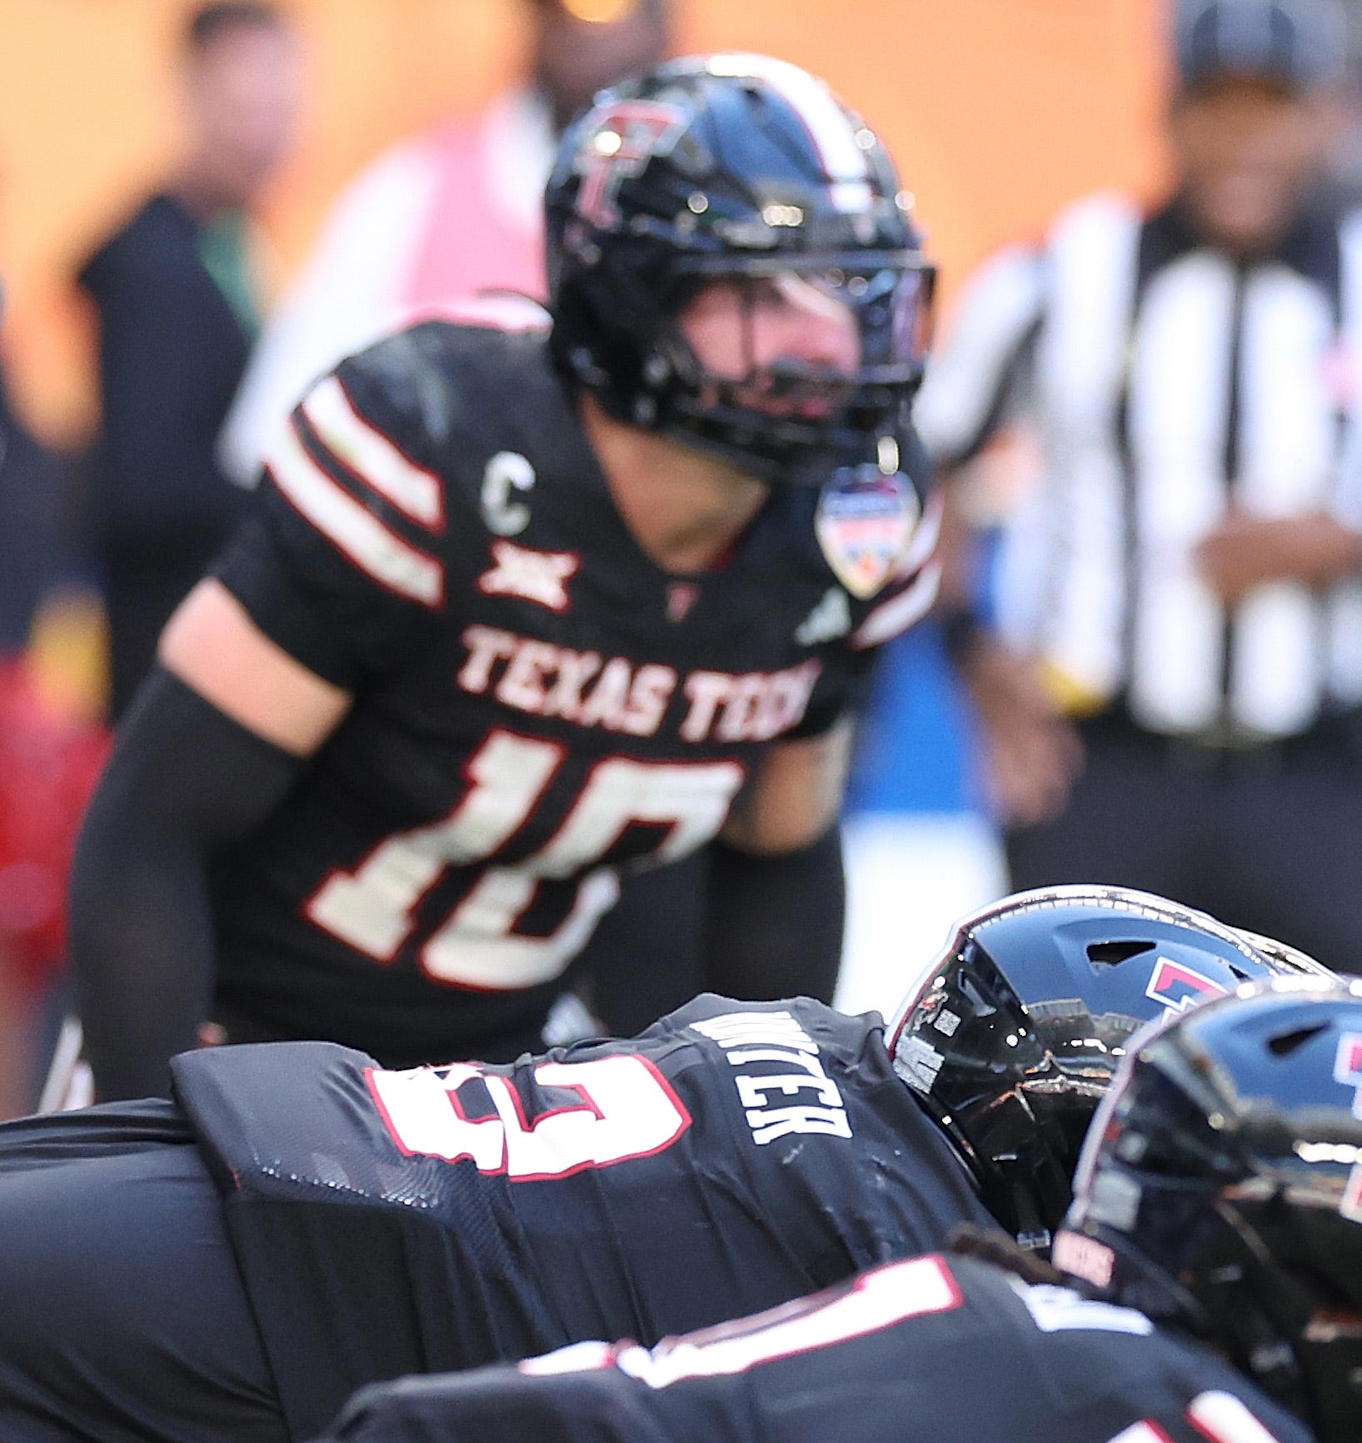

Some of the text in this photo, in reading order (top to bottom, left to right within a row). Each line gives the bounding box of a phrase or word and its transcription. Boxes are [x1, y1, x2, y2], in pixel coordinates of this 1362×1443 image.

[481, 450, 536, 536] C
[457, 623, 679, 737] TEXAS
[303, 726, 746, 991] 10
